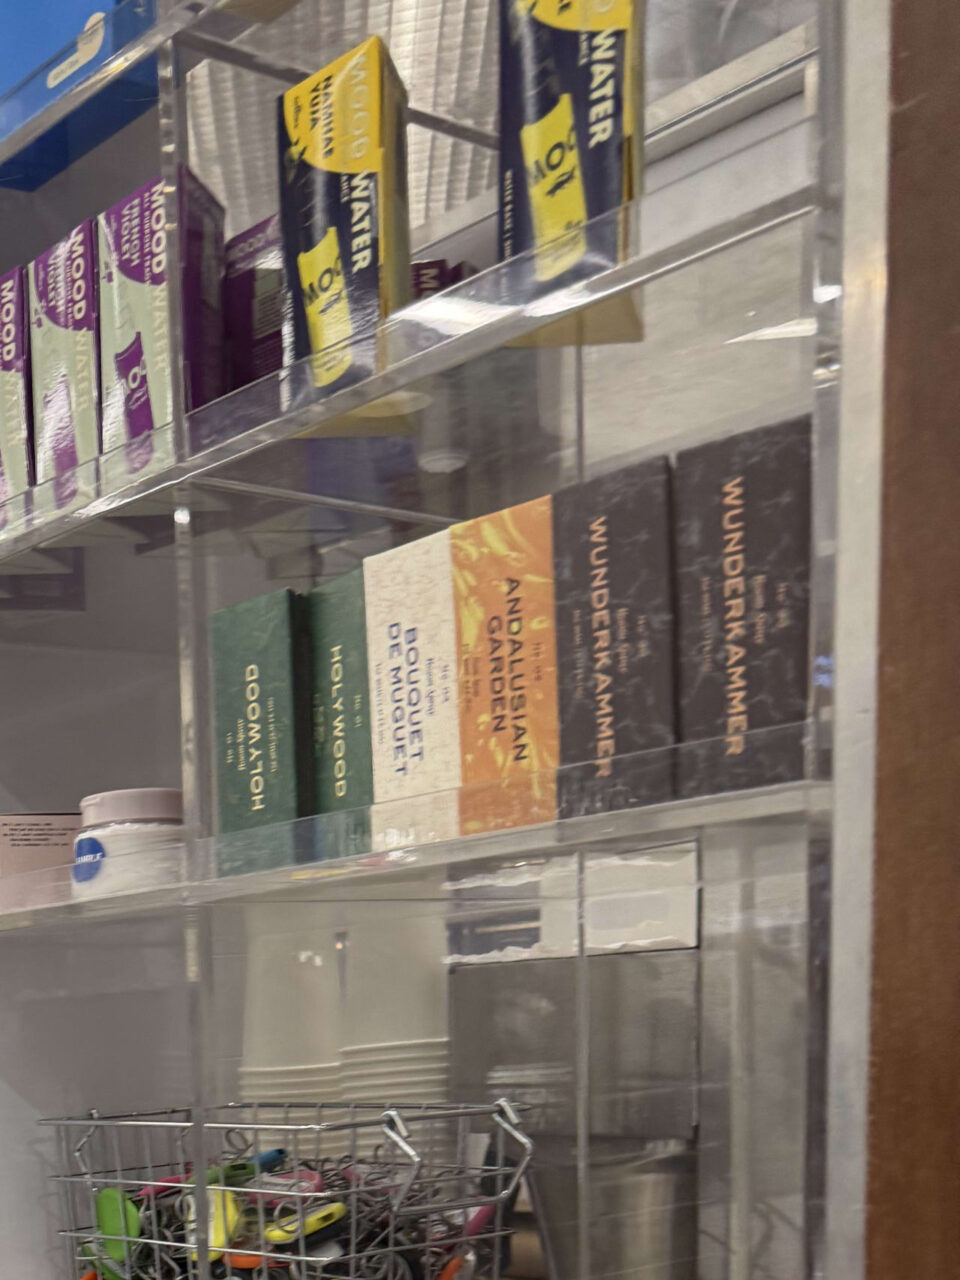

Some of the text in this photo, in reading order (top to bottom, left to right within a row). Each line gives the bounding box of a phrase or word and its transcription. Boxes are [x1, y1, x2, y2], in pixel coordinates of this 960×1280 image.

[350, 53, 371, 160] MOOD
[589, 26, 617, 149] WATER
[68, 229, 86, 321] MOOD
[120, 202, 132, 261] VIOLET
[130, 198, 141, 267] FRENCH
[151, 180, 167, 274] MOOD
[351, 168, 371, 274] WATER
[1, 279, 16, 361] MOOD
[487, 615, 507, 733] GARDEN
[505, 577, 528, 762] ANDALUSIAN
[589, 515, 616, 779] WUNDERKAMMER
[722, 476, 748, 757] WUNDERKAMMER
[245, 663, 266, 812] HOLYWOOD
[329, 644, 347, 797] HOLYWOOD
[388, 622, 408, 777] DE MUGUET
[404, 626, 425, 762] BOUQUET
